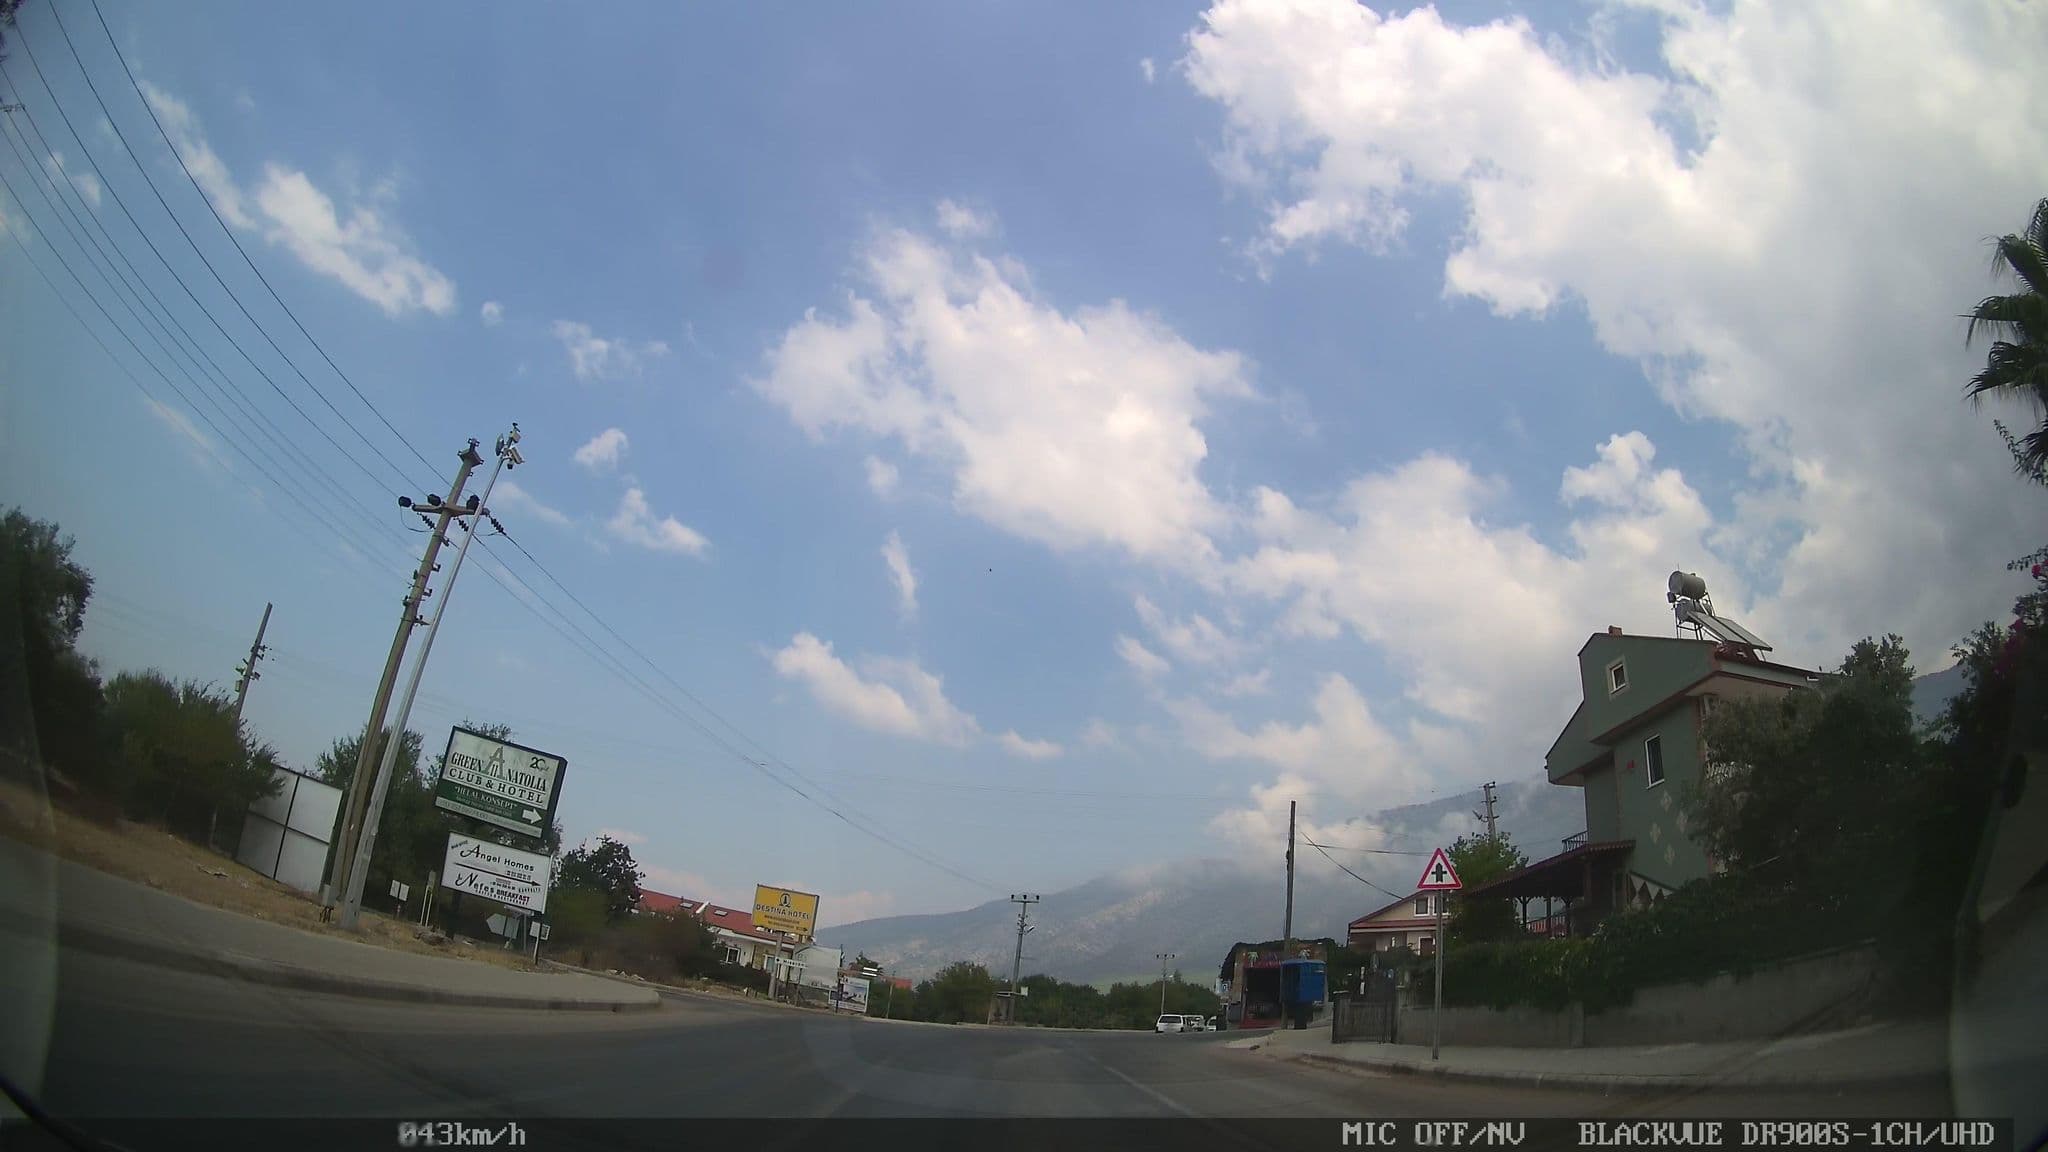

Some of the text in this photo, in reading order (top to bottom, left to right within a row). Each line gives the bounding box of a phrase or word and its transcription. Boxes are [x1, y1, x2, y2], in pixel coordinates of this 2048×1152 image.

[451, 751, 484, 774] GREEN
[449, 768, 543, 803] CLUB & HOTEL
[460, 844, 500, 864] Angel
[504, 858, 535, 872] Homes
[755, 903, 810, 919] DESTINA HOTEL
